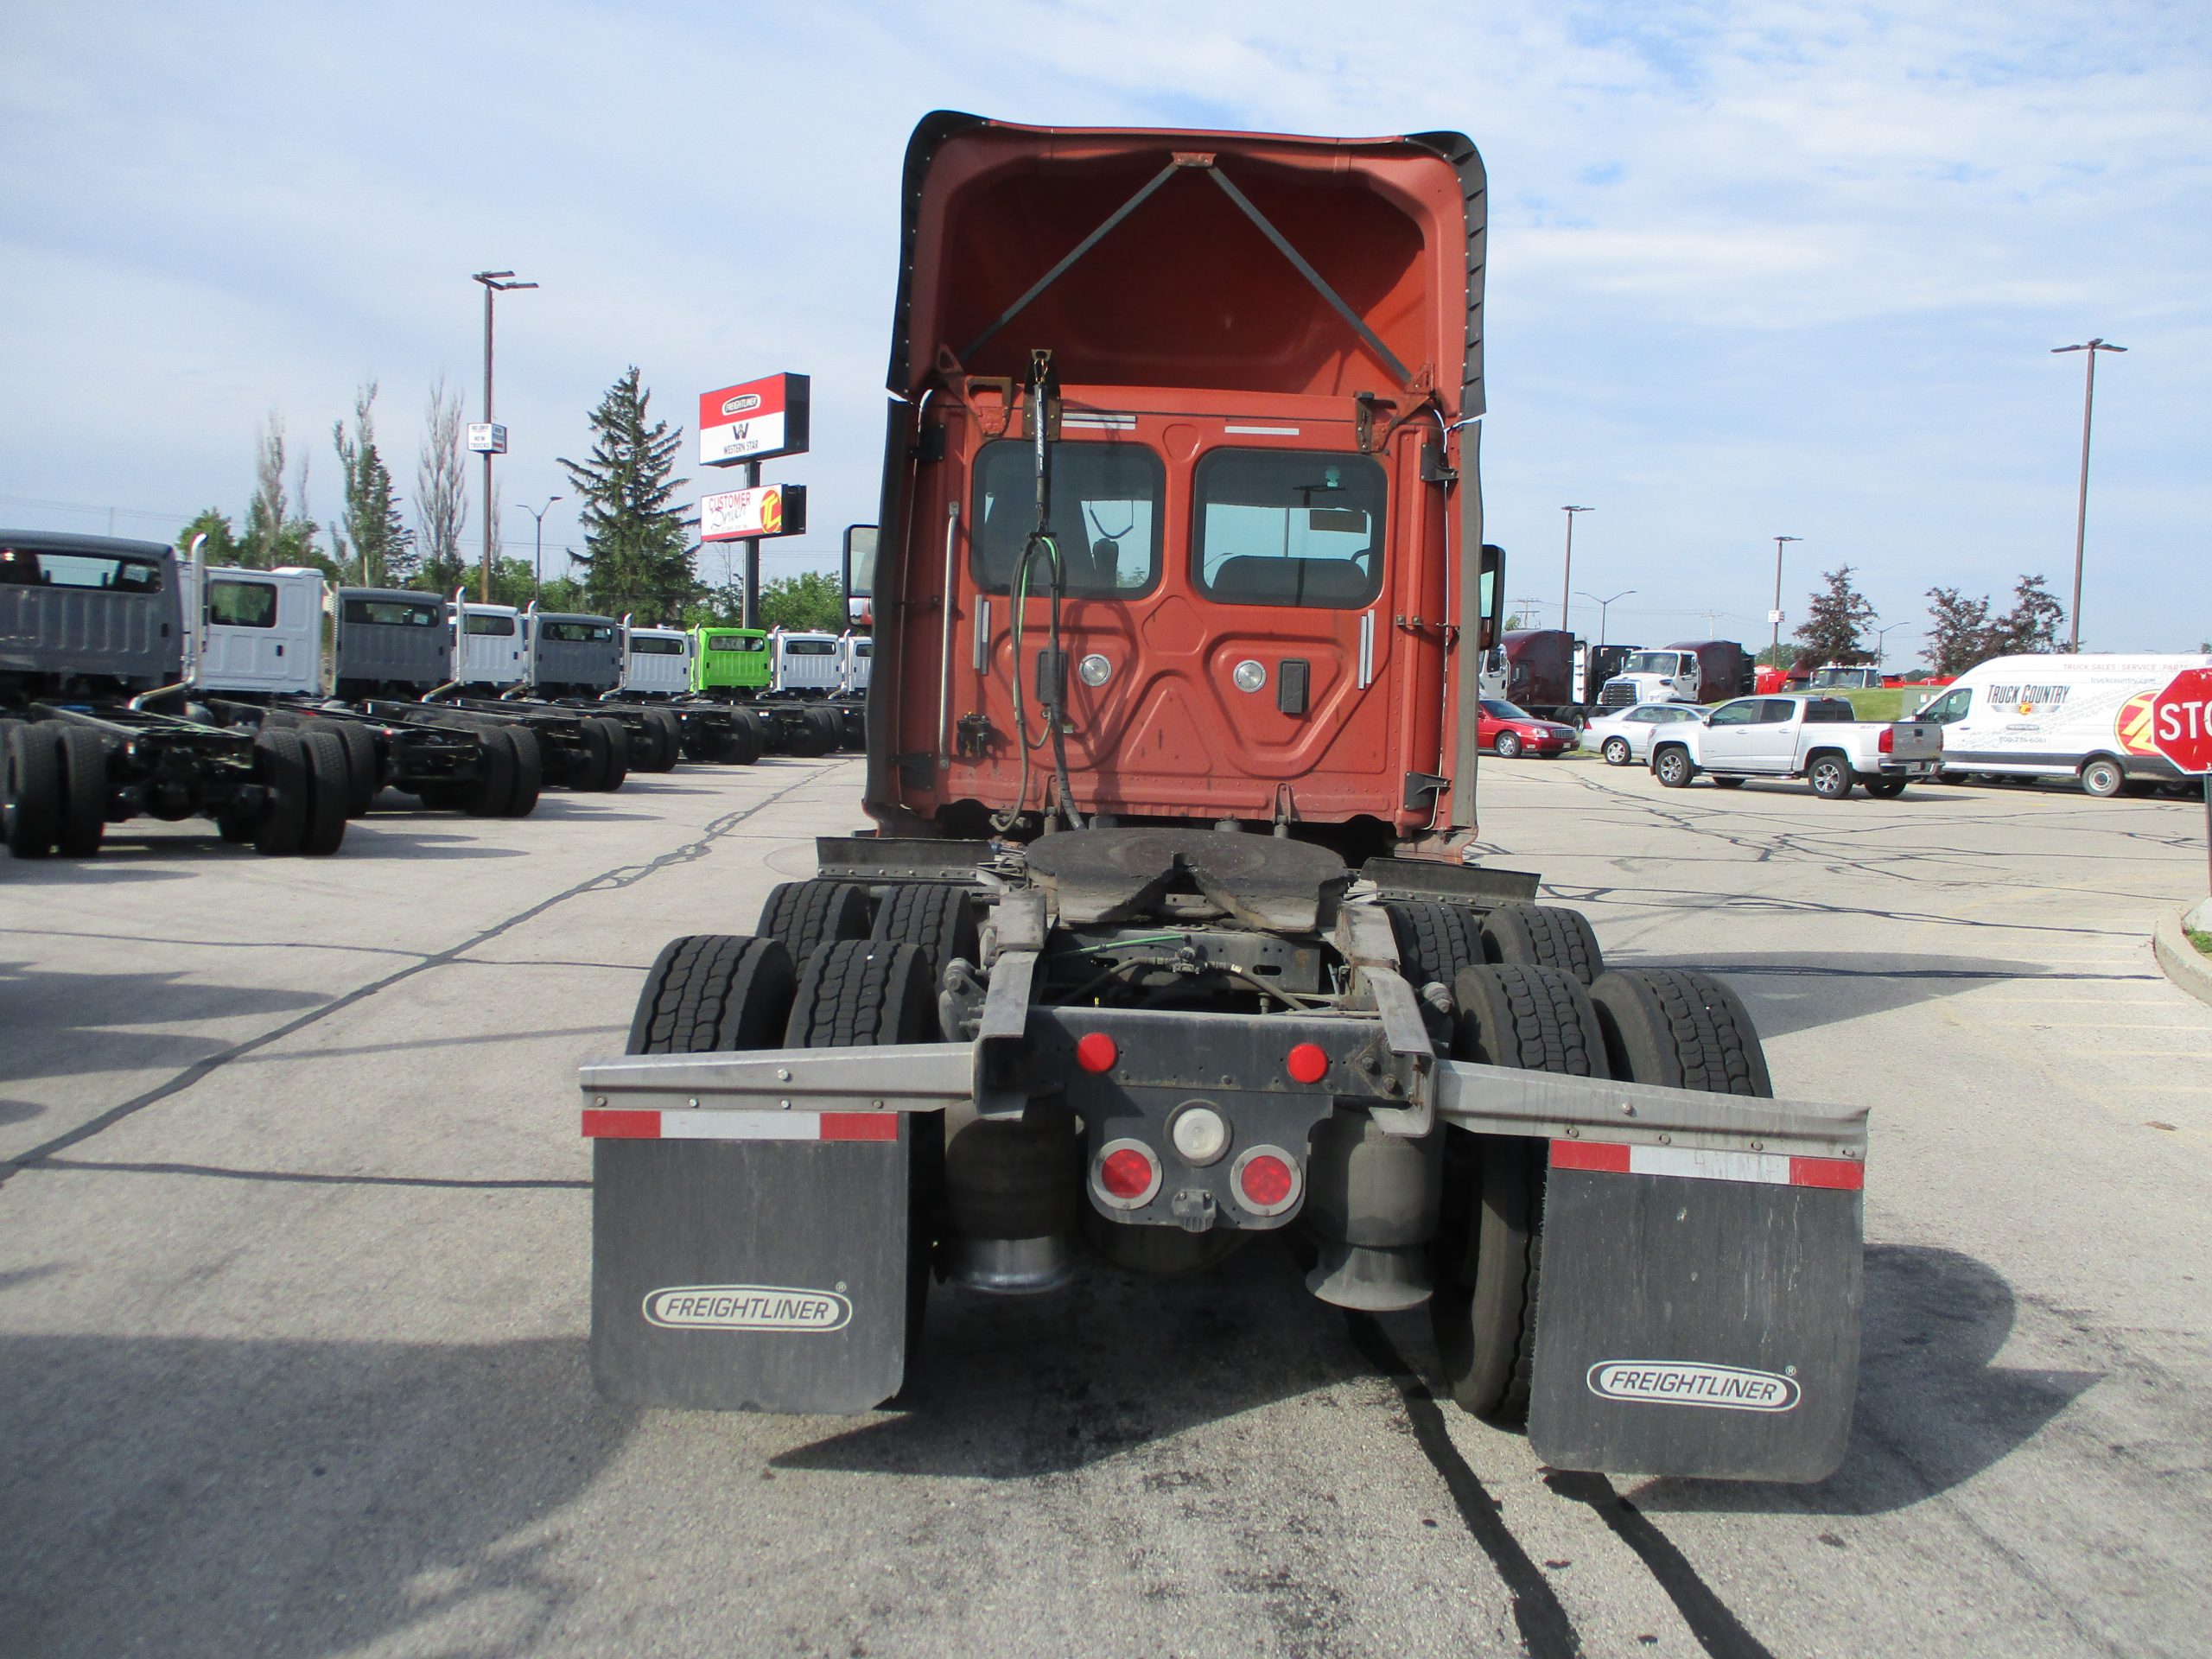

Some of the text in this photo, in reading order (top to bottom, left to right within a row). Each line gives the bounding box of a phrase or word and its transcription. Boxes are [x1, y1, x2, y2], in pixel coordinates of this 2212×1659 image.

[747, 439, 759, 451] STAR
[709, 492, 751, 512] CUSTOMER
[1986, 684, 2071, 703] TRUCK COUNTRY
[664, 1297, 830, 1320] FREIGHTLINER
[1609, 1370, 1777, 1401] FREIGHTLINER
